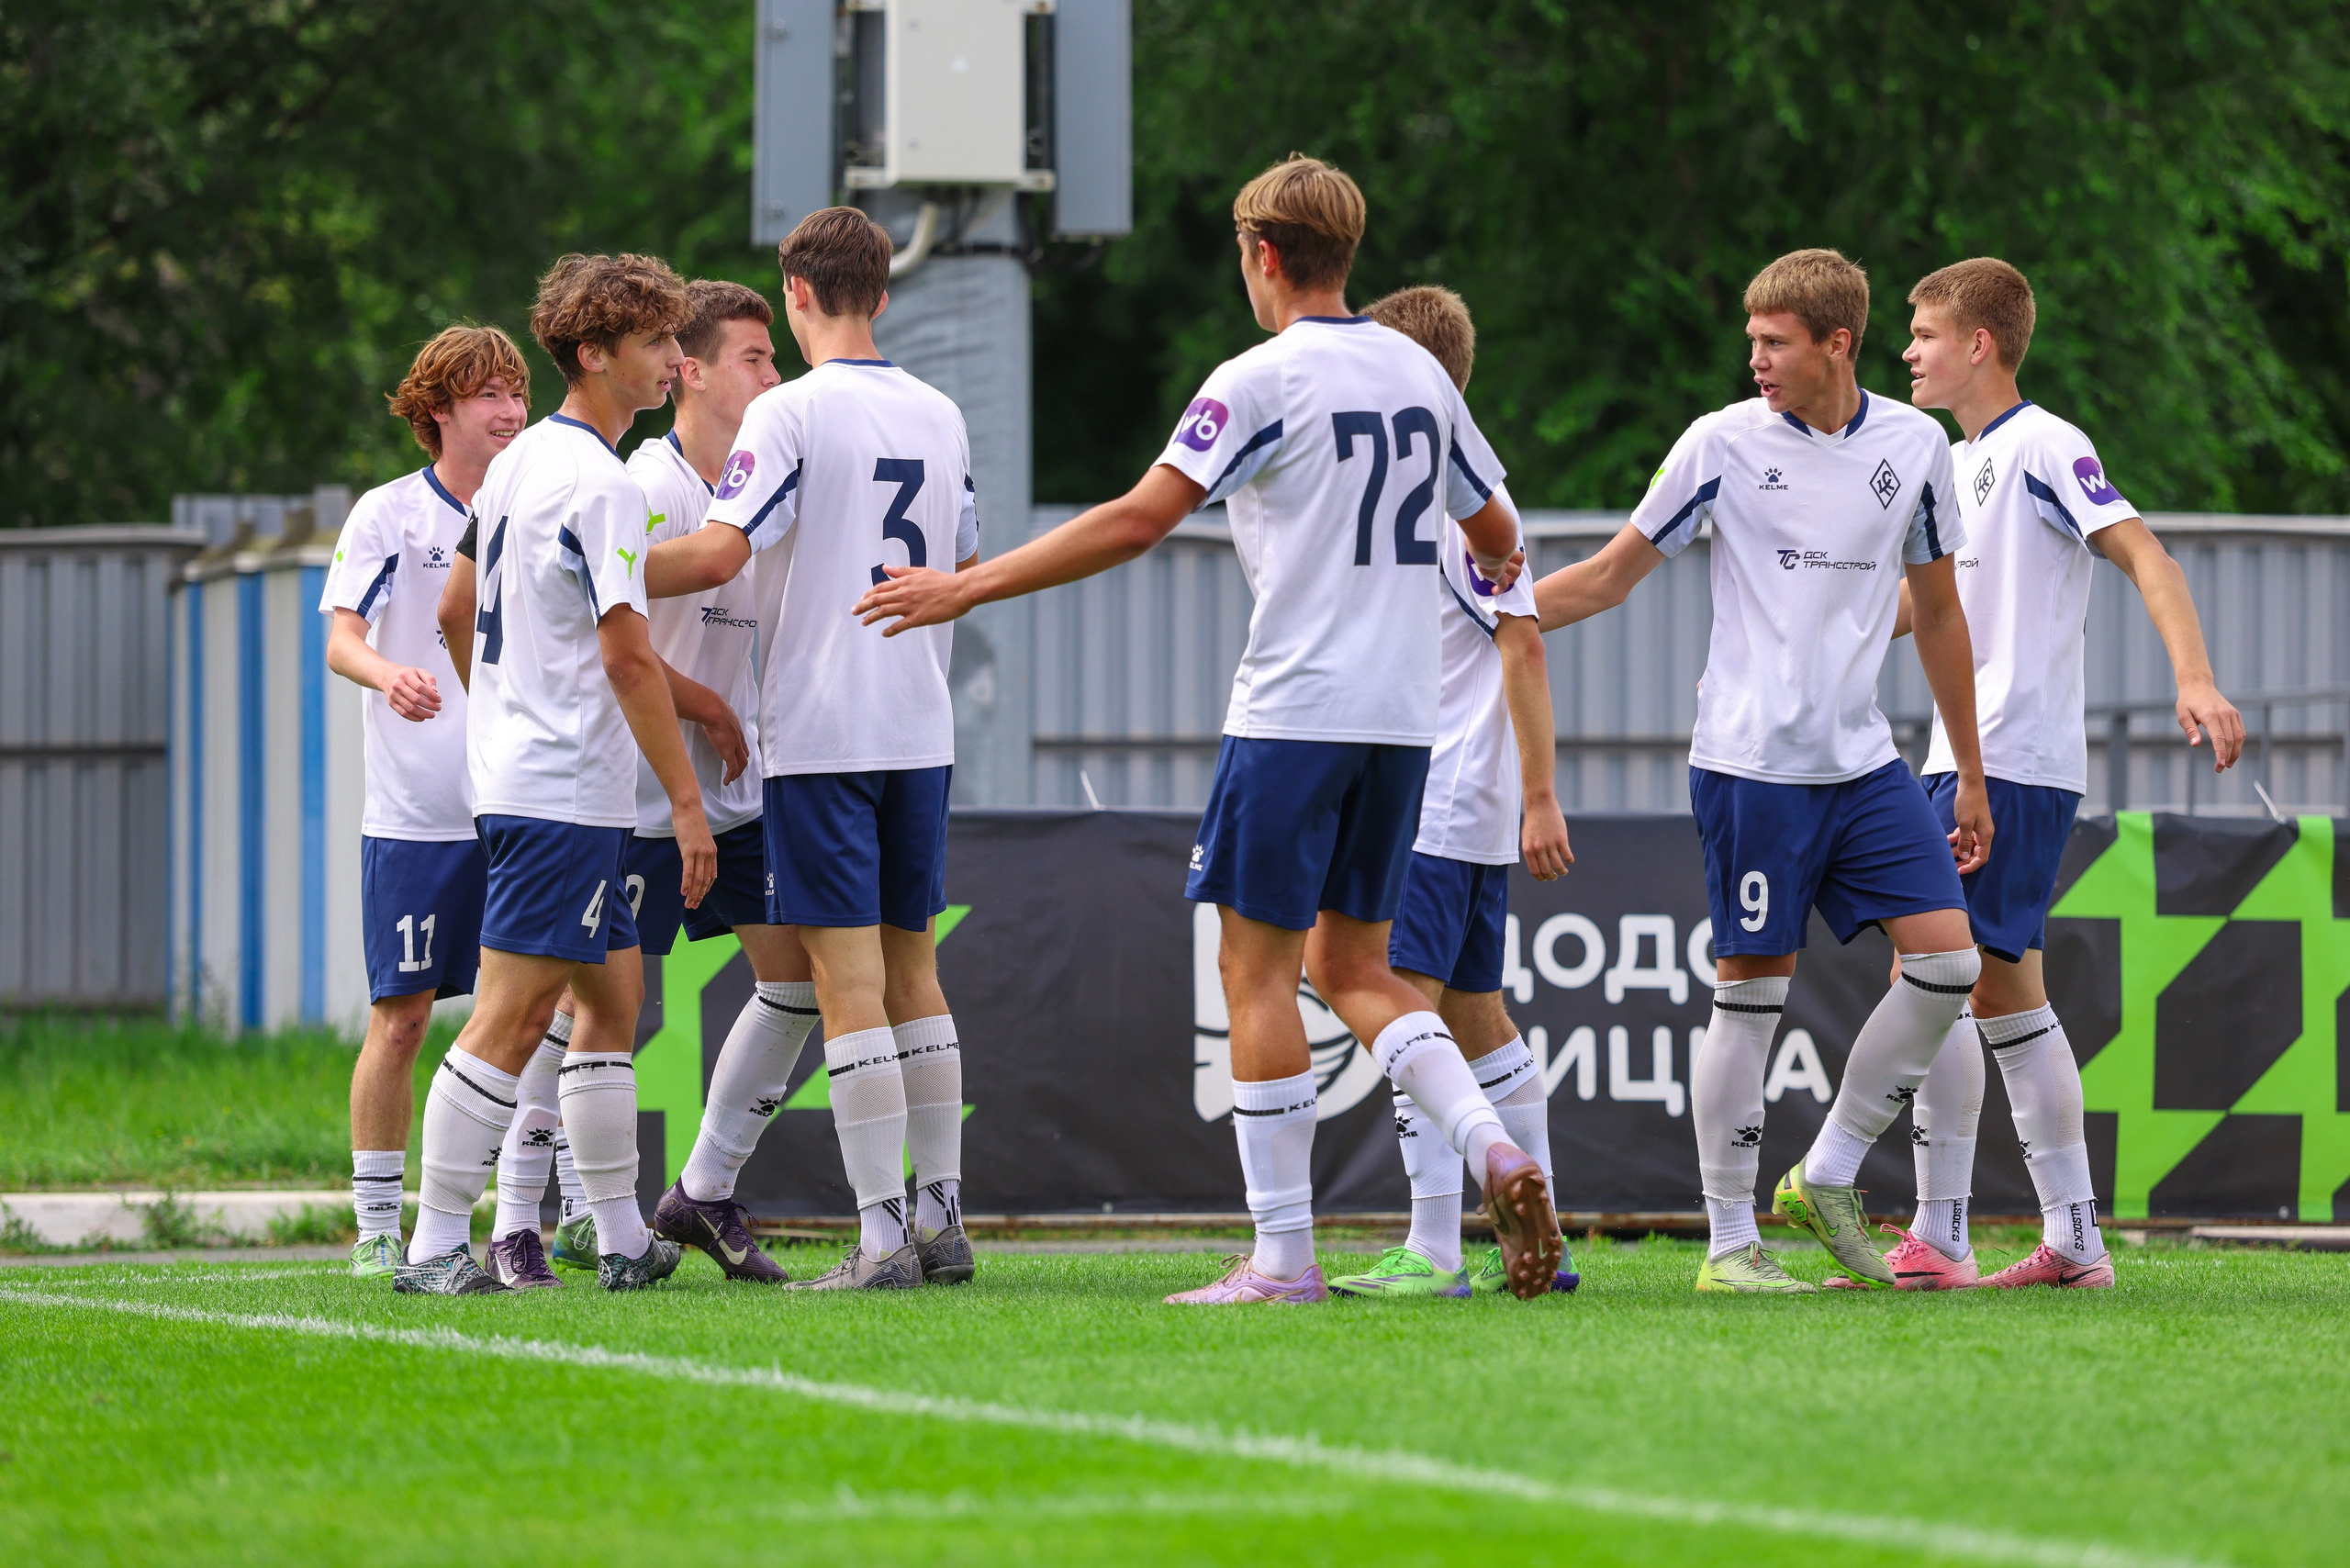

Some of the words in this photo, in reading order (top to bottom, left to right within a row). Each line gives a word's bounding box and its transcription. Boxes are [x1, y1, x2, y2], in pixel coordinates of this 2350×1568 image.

[1332, 406, 1440, 566] 72
[870, 457, 927, 588] 3
[1803, 561, 1877, 571] ТРАНССТРОЙ
[1804, 551, 1829, 559] ДСК
[476, 515, 509, 666] 4
[581, 879, 608, 938] 4
[1740, 870, 1770, 933] 9
[396, 914, 436, 973] 11
[857, 1054, 899, 1069] KELM
[912, 1041, 960, 1057] KELME
[1386, 1031, 1432, 1076] KELME
[1514, 1055, 1535, 1075] KEL
[1528, 1024, 1834, 1118] ИЦА
[749, 1107, 773, 1117] KEL
[1289, 1095, 1318, 1113] KEL
[1886, 1092, 1909, 1103] KEL
